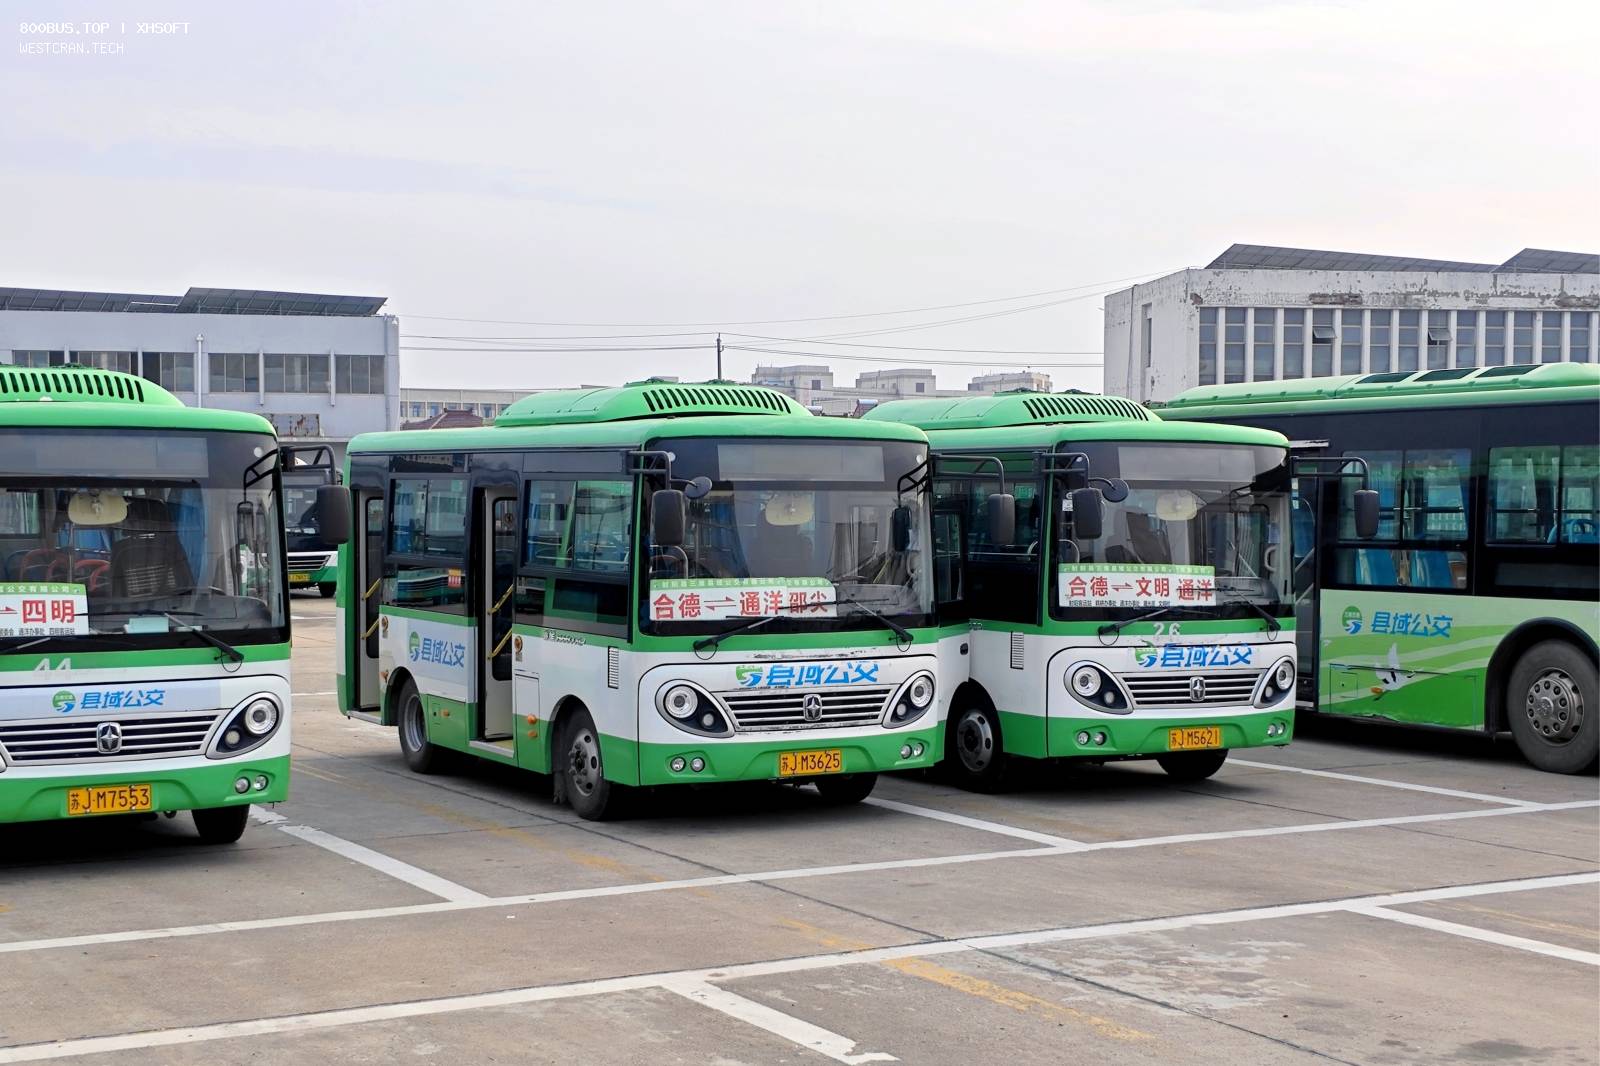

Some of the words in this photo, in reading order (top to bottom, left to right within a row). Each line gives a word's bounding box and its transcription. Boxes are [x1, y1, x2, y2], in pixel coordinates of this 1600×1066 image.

[1068, 575, 1109, 597] 合德
[1135, 576, 1170, 598] 文明
[22, 599, 75, 624] 四明
[653, 592, 701, 620] 合德
[1370, 611, 1453, 638] 县域公交
[421, 637, 466, 668] 县域公交
[1160, 642, 1252, 667] 县域公交
[33, 657, 72, 679] 44
[80, 689, 166, 710] 县域公交
